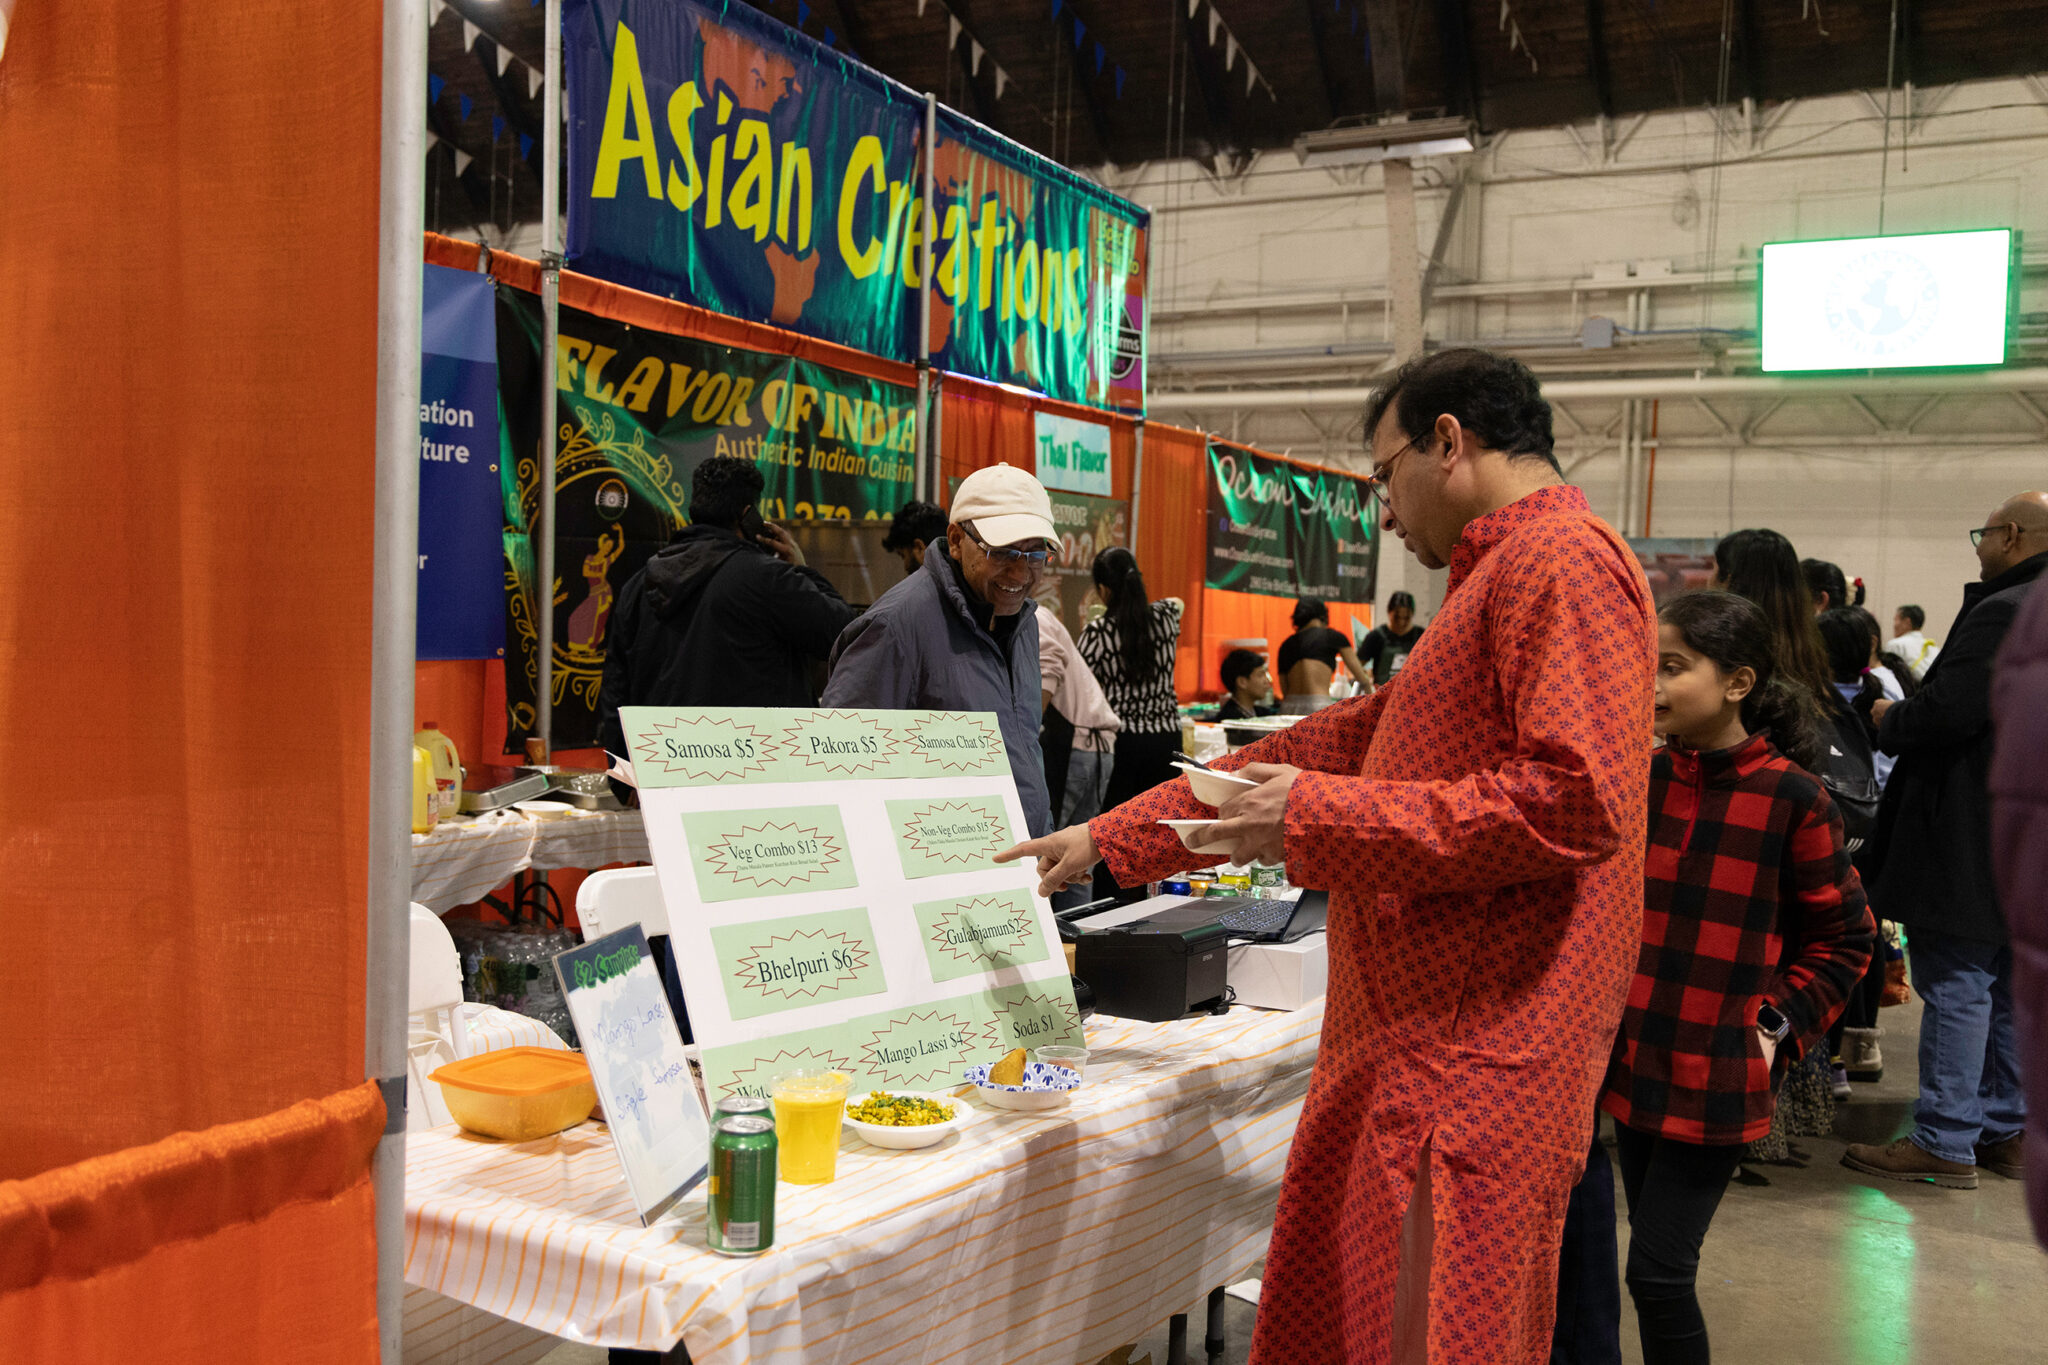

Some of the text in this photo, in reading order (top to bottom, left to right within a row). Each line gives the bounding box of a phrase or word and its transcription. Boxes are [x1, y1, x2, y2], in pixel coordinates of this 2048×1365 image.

[591, 20, 1083, 338] Asian Creations
[557, 333, 916, 454] FLAVOR OF INDIA
[420, 399, 475, 428] ation
[808, 444, 866, 476] Indian
[869, 454, 915, 483] Cuisin
[1039, 434, 1108, 474] Thai Flavor
[1219, 455, 1295, 506] Ocean
[1050, 496, 1088, 526] lavor
[665, 737, 755, 760] Samosa $5
[810, 735, 878, 755] Pakora $5
[918, 734, 990, 749] Samosa Chat $7
[920, 821, 989, 838] Non-Veg Combo $15
[728, 838, 818, 863] Veg Combo $13
[947, 918, 1022, 945] Gulabjamun$2
[574, 960, 597, 988] $2
[758, 947, 853, 983] Bhelpuri $6
[1013, 1014, 1055, 1040] Soda $1
[877, 1031, 964, 1066] Mango Lassi $4
[737, 1085, 772, 1099] Wat
